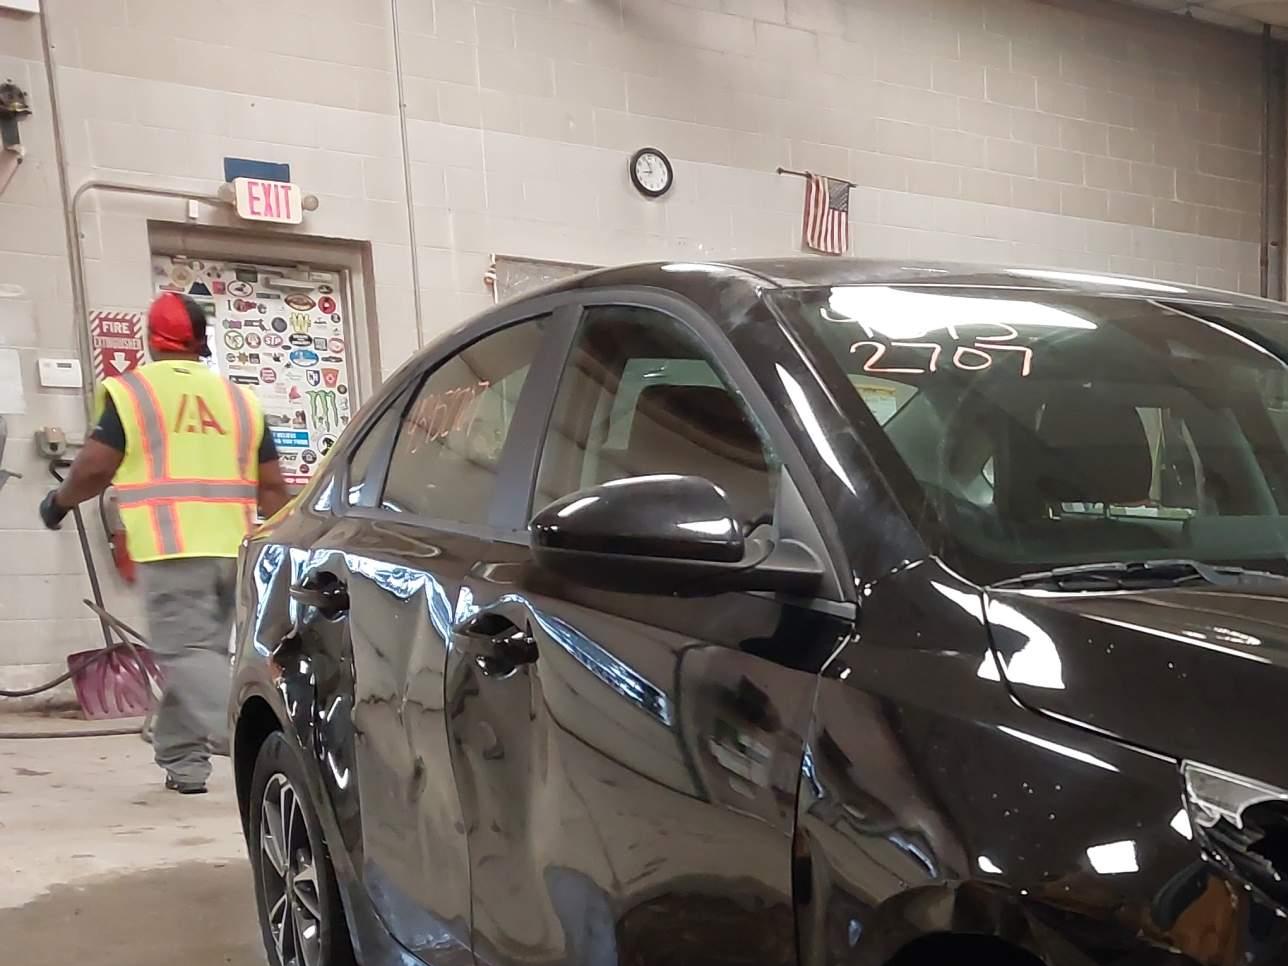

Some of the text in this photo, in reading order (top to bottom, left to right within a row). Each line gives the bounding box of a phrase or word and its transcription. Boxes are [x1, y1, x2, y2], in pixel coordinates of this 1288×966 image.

[248, 181, 292, 219] EXIT
[102, 320, 131, 335] FIRE
[94, 337, 142, 350] EXTSHER
[849, 341, 1033, 376] 2707
